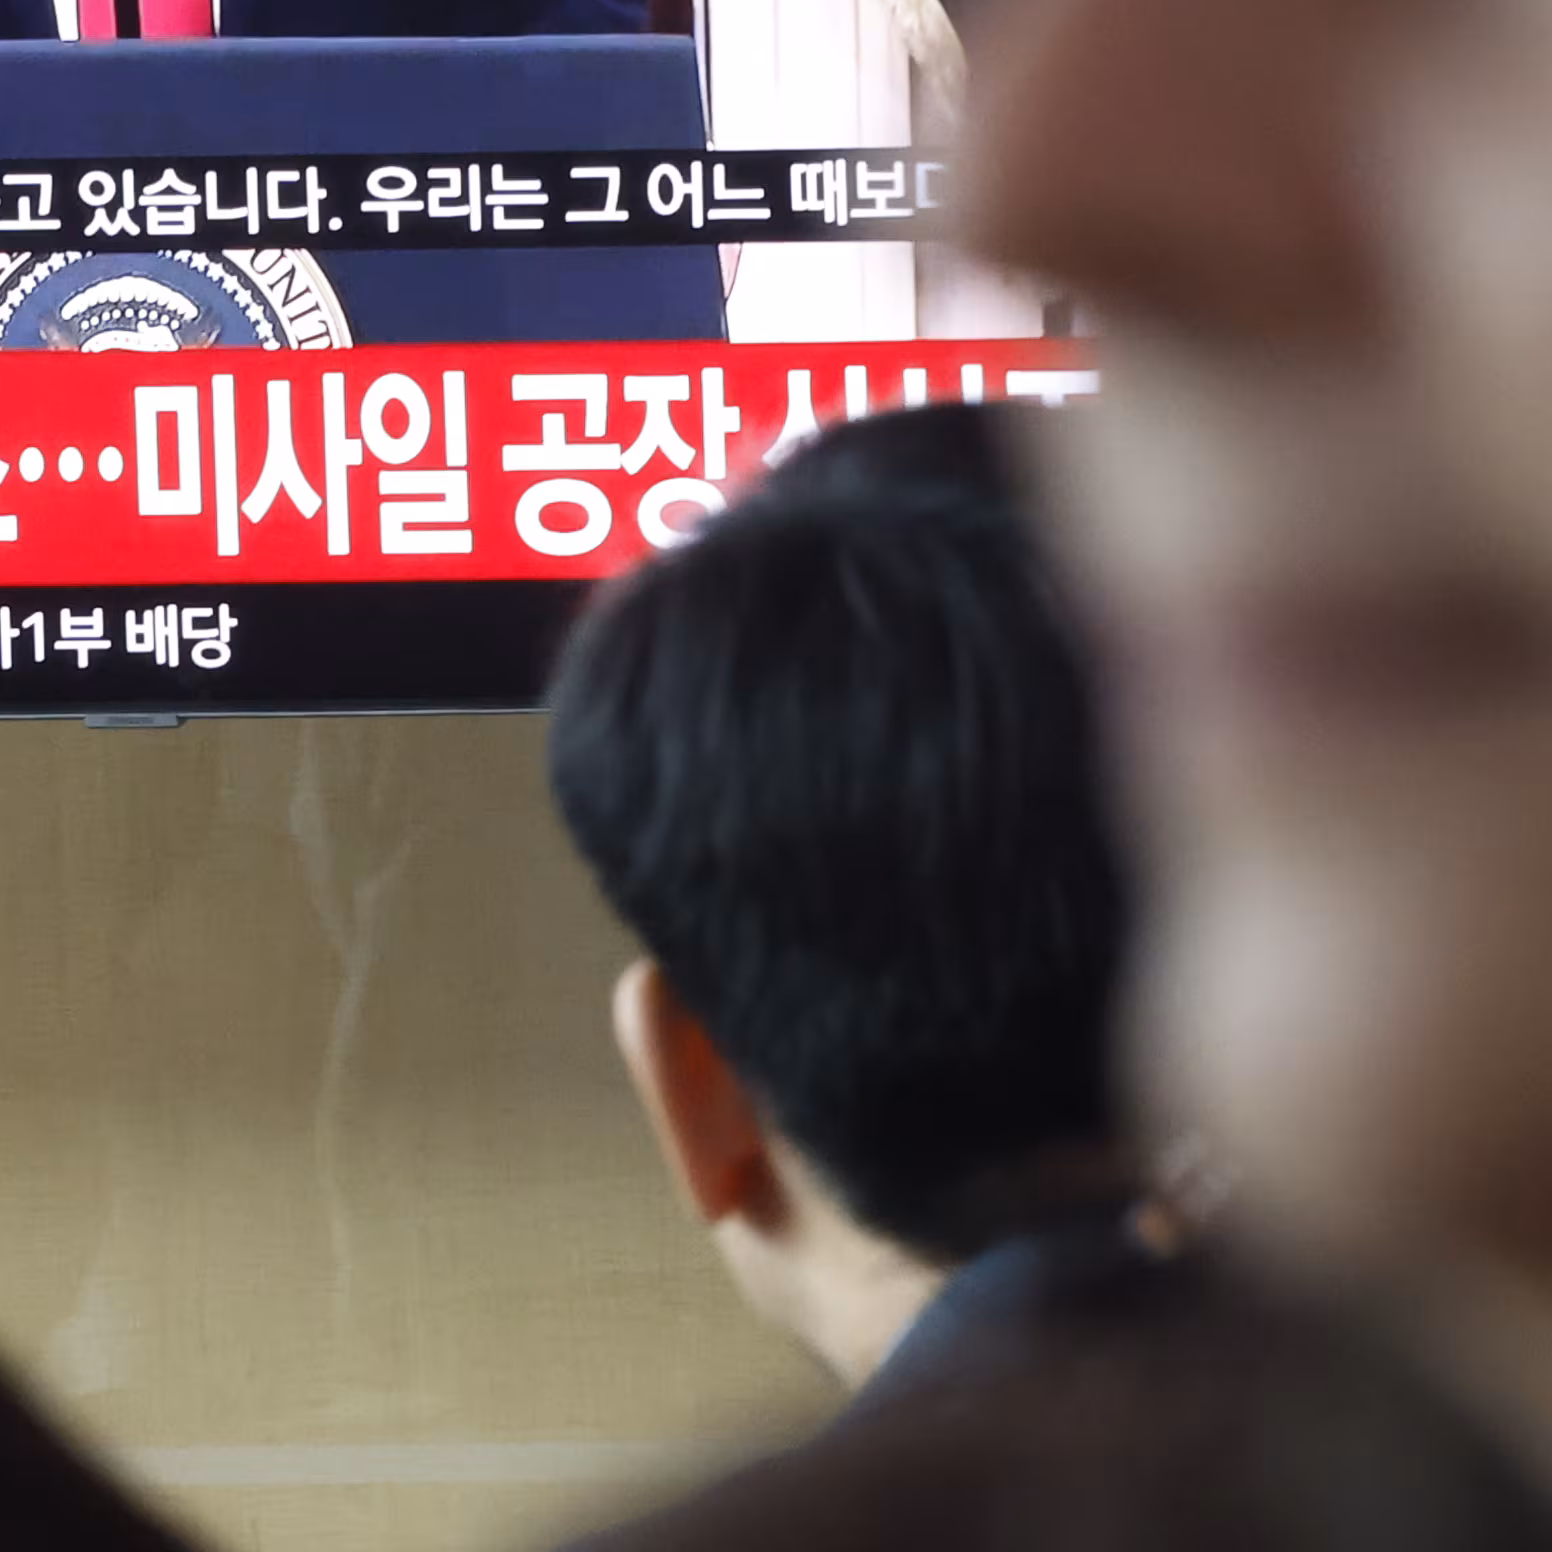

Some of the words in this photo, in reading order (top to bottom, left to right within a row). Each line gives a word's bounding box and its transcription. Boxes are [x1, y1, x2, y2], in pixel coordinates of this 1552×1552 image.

[77, 165, 343, 237] 있습니다.
[360, 163, 549, 233] 우리는
[564, 166, 630, 223] 그
[646, 160, 772, 229] 어느
[501, 367, 741, 556] 공장
[125, 602, 239, 669] 배당
